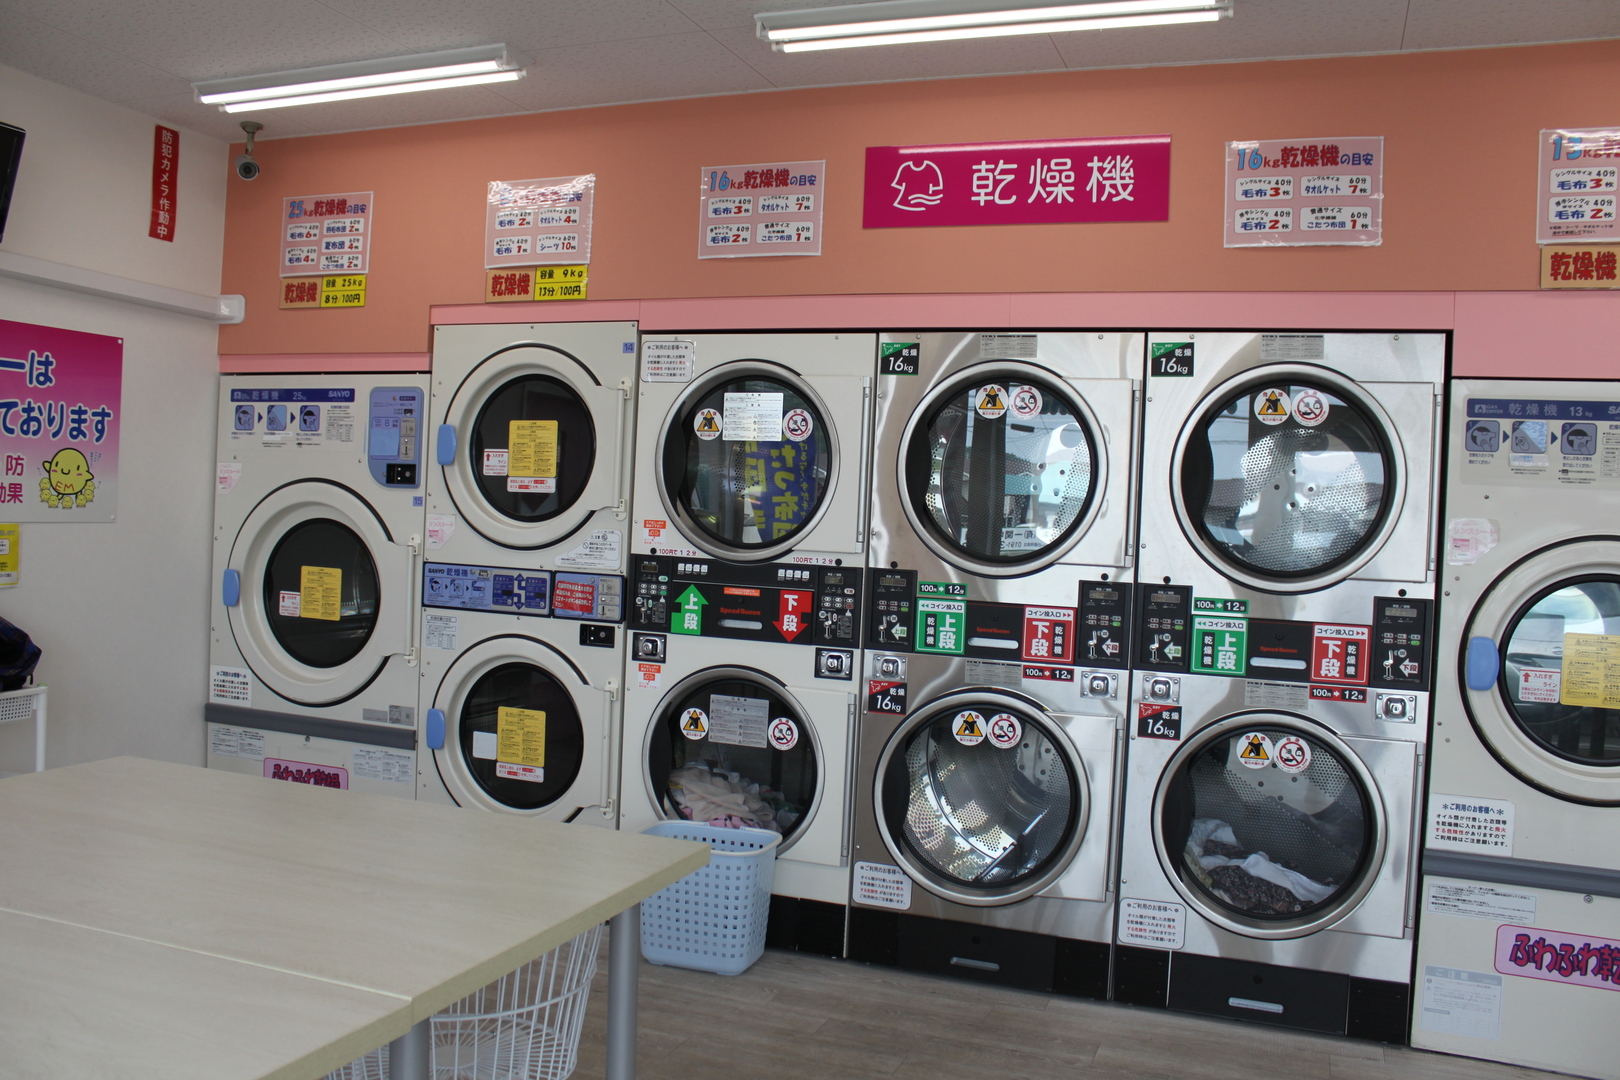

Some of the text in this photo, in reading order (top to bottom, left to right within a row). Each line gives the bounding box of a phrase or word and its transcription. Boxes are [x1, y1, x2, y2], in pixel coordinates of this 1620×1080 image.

[1237, 144, 1374, 171] 16kg乾燥機の目安
[157, 129, 173, 238] 防犯カメラ作動中
[709, 168, 817, 192] 16kg乾燥機の目安
[971, 155, 1135, 206] 乾燥機
[288, 198, 367, 219] 25kg乾燥機の目安
[1550, 251, 1617, 281] 乾燥機
[540, 270, 554, 279] 容量
[326, 278, 362, 288] 容量 25kg
[491, 273, 531, 297] 乾燥機
[284, 282, 318, 303] 乾燥機
[539, 285, 581, 297] 13分/100円
[623, 343, 635, 351] 14
[1174, 348, 1193, 357] 乾燥
[889, 357, 914, 373] 16kg
[1159, 357, 1189, 375] 16kg
[328, 390, 351, 398] SANYO
[1508, 402, 1558, 417] 乾燥機
[1569, 406, 1583, 416] 13
[446, 567, 468, 577] 乾燥機
[920, 584, 965, 595] 100円 12分
[683, 593, 698, 630] 上段
[720, 606, 761, 616] Speed Queen
[782, 594, 799, 632] 下段
[930, 603, 963, 611] コイン投入口
[1196, 600, 1246, 611] 100円 12分
[1027, 609, 1061, 618] コイン投入口
[926, 617, 935, 645] 乾燥機
[938, 614, 957, 650] 上段
[1208, 621, 1244, 629] コイン投入口
[1316, 627, 1355, 637] コイン投入口
[1030, 621, 1050, 657] 下段
[1053, 626, 1064, 655] 乾燥機
[1105, 643, 1118, 652] 下段
[1203, 635, 1213, 666] 乾燥機
[1217, 632, 1237, 670] 上段
[1320, 639, 1342, 678] 下段
[1346, 644, 1357, 676] 乾燥機
[1025, 668, 1072, 680] 100円 12分
[1402, 663, 1418, 672] 下段
[889, 687, 905, 696] 乾燥
[1543, 681, 1558, 689] ライン
[1312, 689, 1364, 700] 100円 12分
[876, 695, 901, 712] 16kg
[1161, 711, 1180, 720] 乾燥
[1147, 719, 1176, 737] 16kg
[1131, 902, 1173, 912] ご利用のお客様へ
